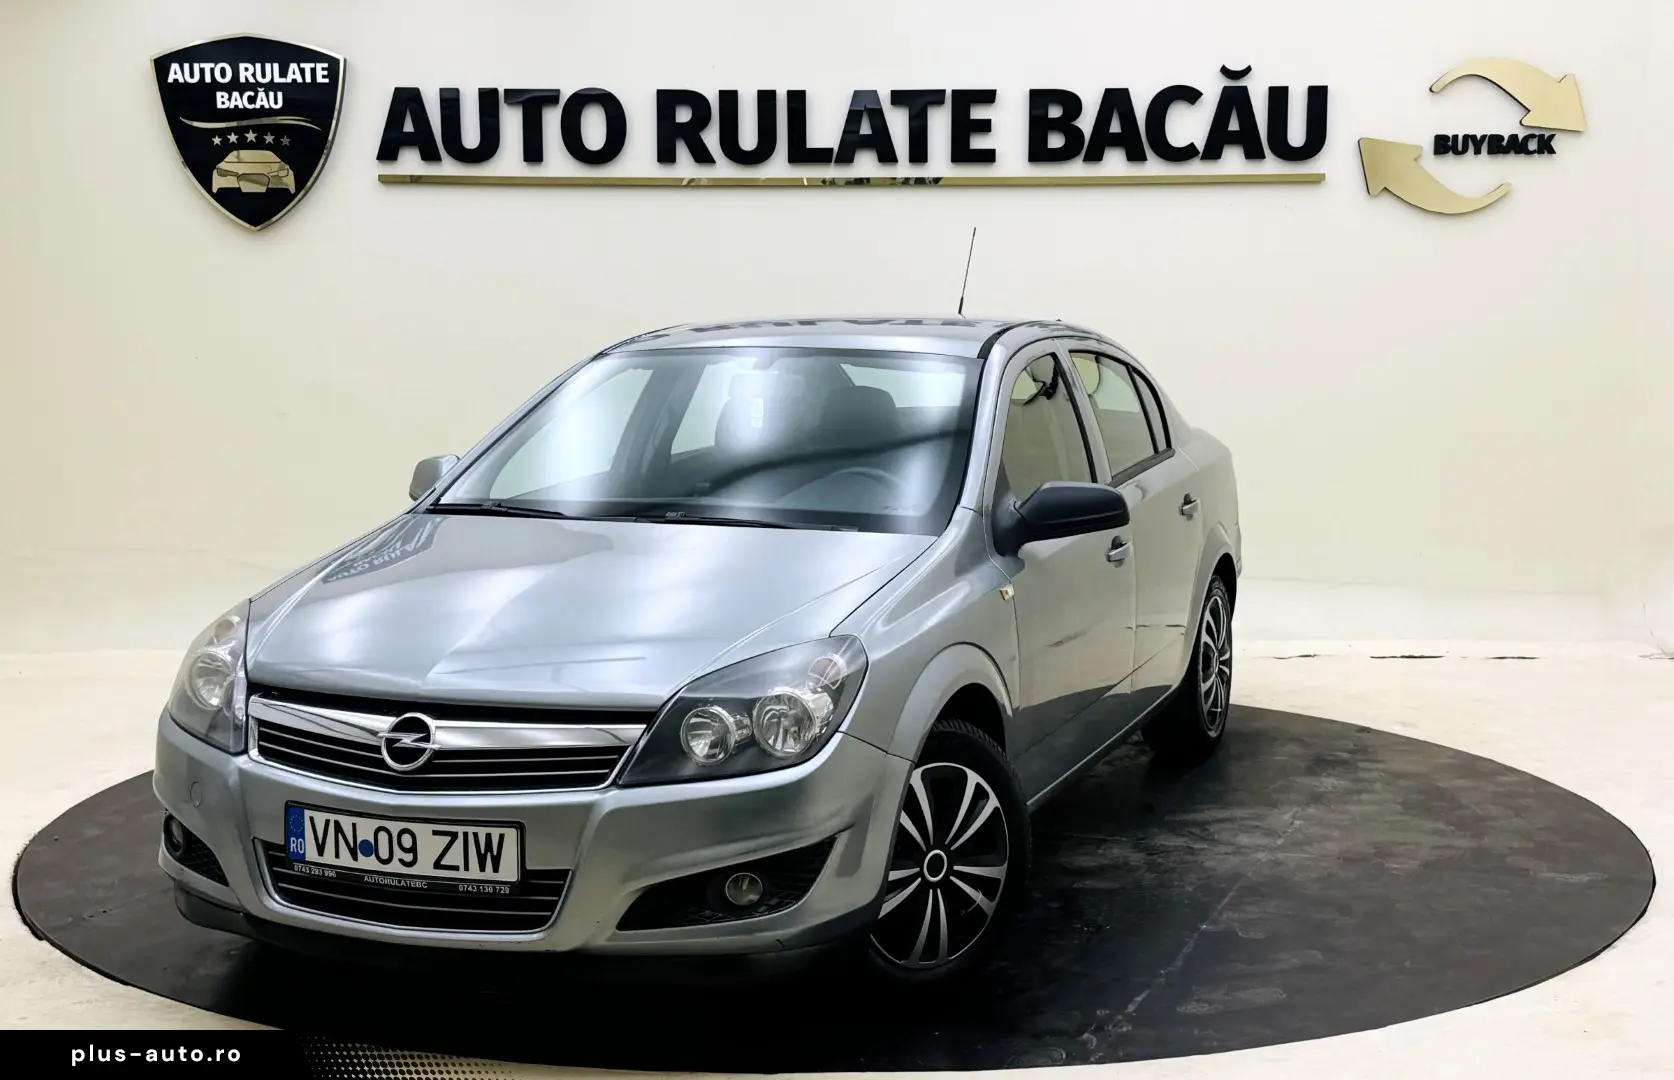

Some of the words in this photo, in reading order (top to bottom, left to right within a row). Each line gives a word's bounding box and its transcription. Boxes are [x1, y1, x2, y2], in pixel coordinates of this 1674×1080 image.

[167, 62, 233, 84] AUTO
[238, 62, 330, 84] RULATE
[215, 87, 284, 109] BACĂU
[375, 86, 628, 165] AUTO
[656, 88, 998, 165] RULATE
[1027, 63, 1329, 163] BACĂU
[1433, 133, 1557, 156] BUYBACK
[290, 837, 305, 854] RO
[309, 815, 359, 863] VN
[373, 825, 419, 868] 09
[431, 829, 506, 874] ZIW
[363, 875, 428, 889] AUTORULATEBC
[458, 884, 477, 892] 0743
